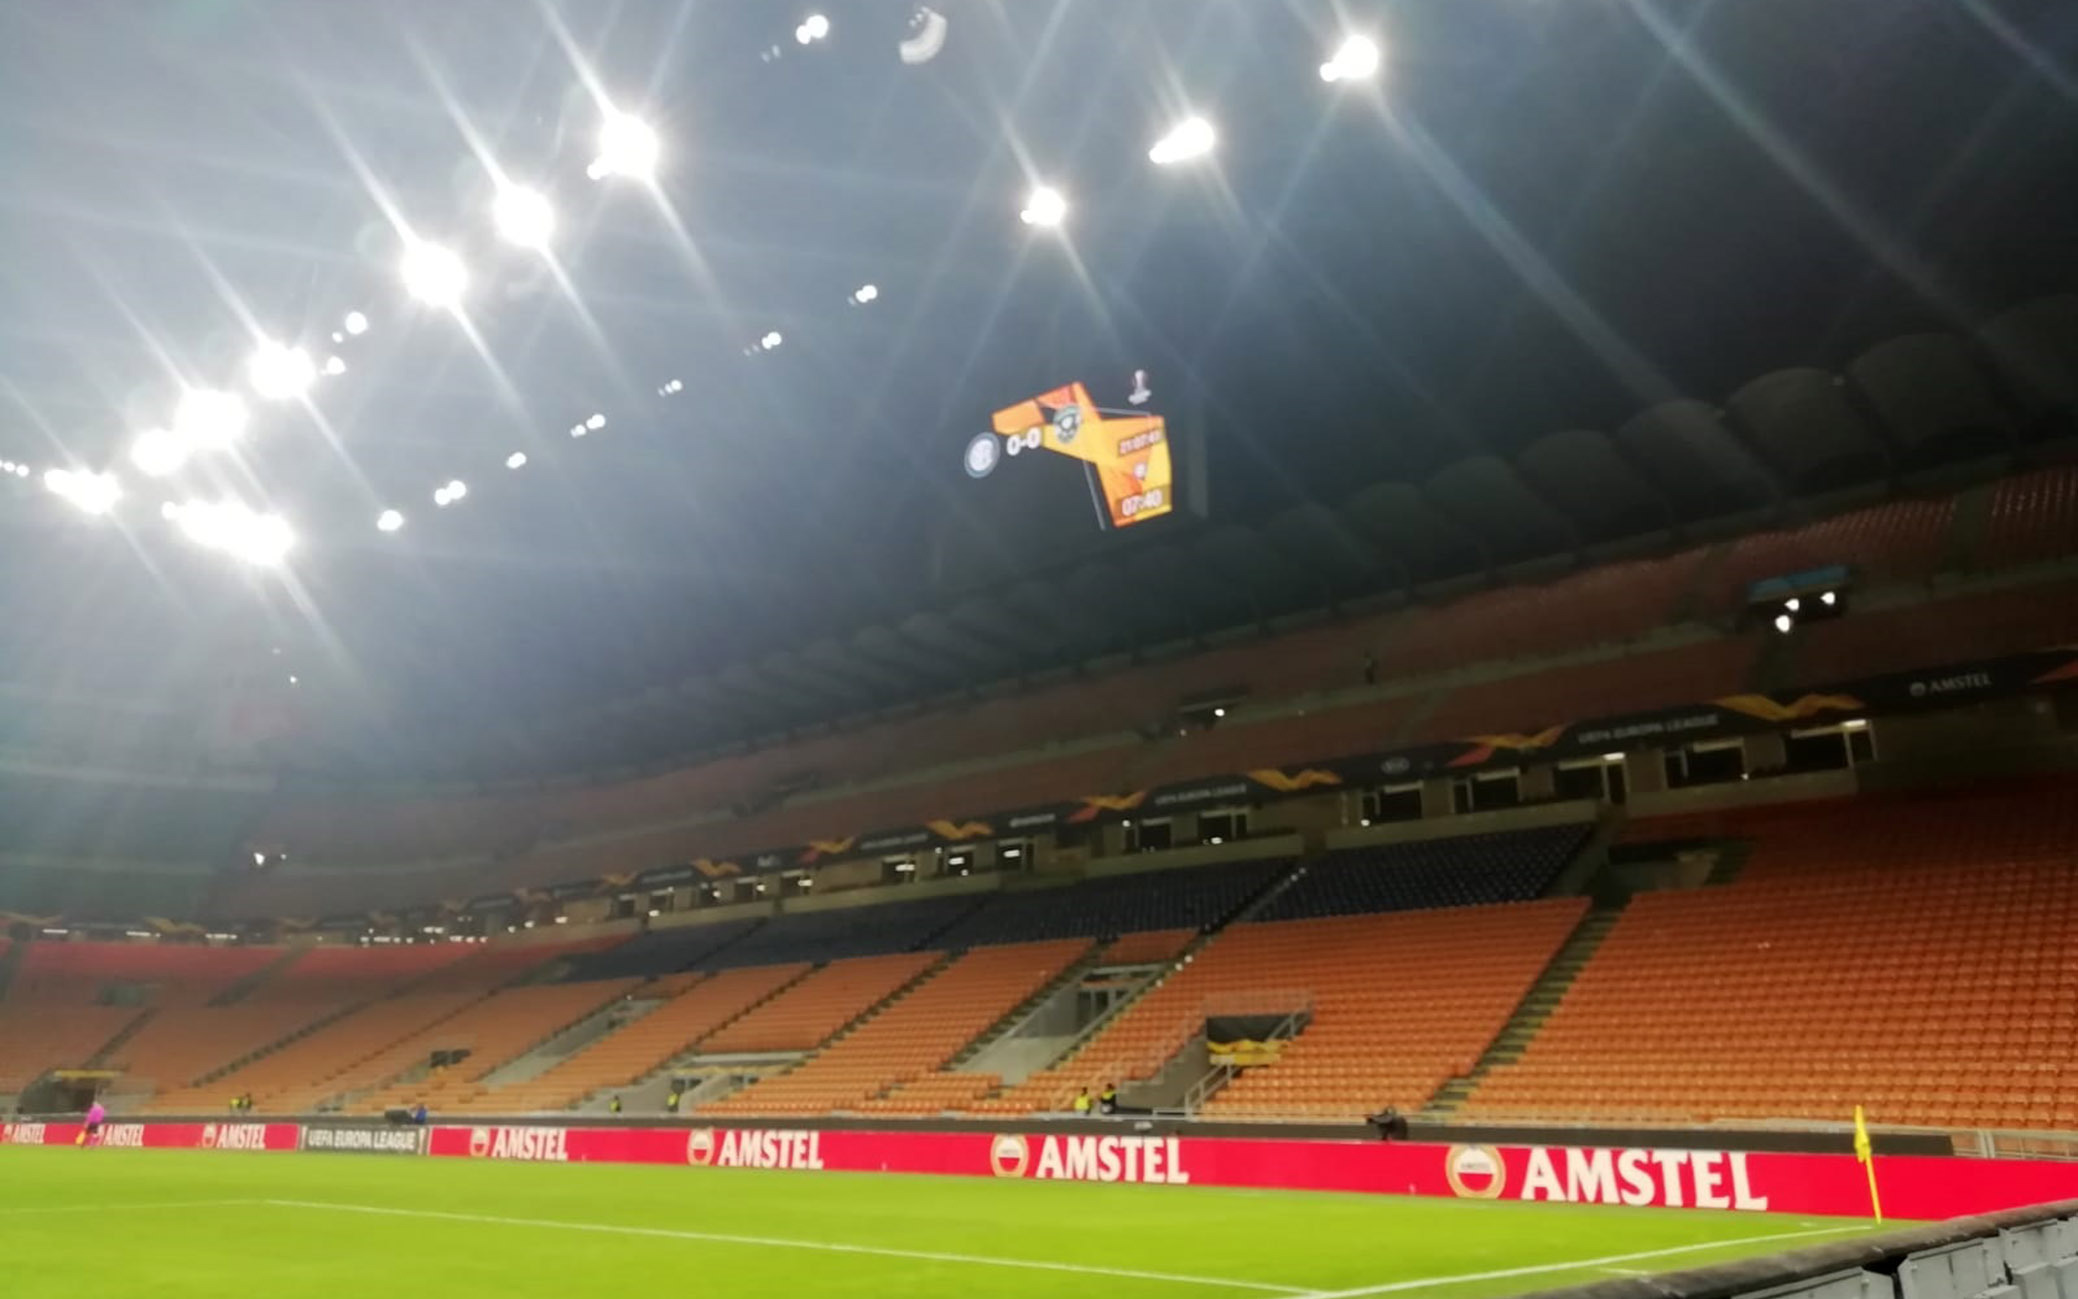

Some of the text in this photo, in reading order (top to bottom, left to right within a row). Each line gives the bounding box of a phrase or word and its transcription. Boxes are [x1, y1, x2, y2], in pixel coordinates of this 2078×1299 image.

[1006, 427, 1042, 456] 0-0
[1930, 672, 1992, 695] AMSTEL
[11, 1123, 46, 1145] AMSTEL
[104, 1123, 145, 1146] AMSTEL
[216, 1123, 266, 1149] AMSTEL
[308, 1129, 416, 1151] UEFA EUROPA LEAGUE
[491, 1128, 568, 1161] AMSTEL
[717, 1130, 823, 1170] AMSTEL
[1035, 1134, 1189, 1184] AMSTEL
[1520, 1147, 1768, 1211] AMSTEL
